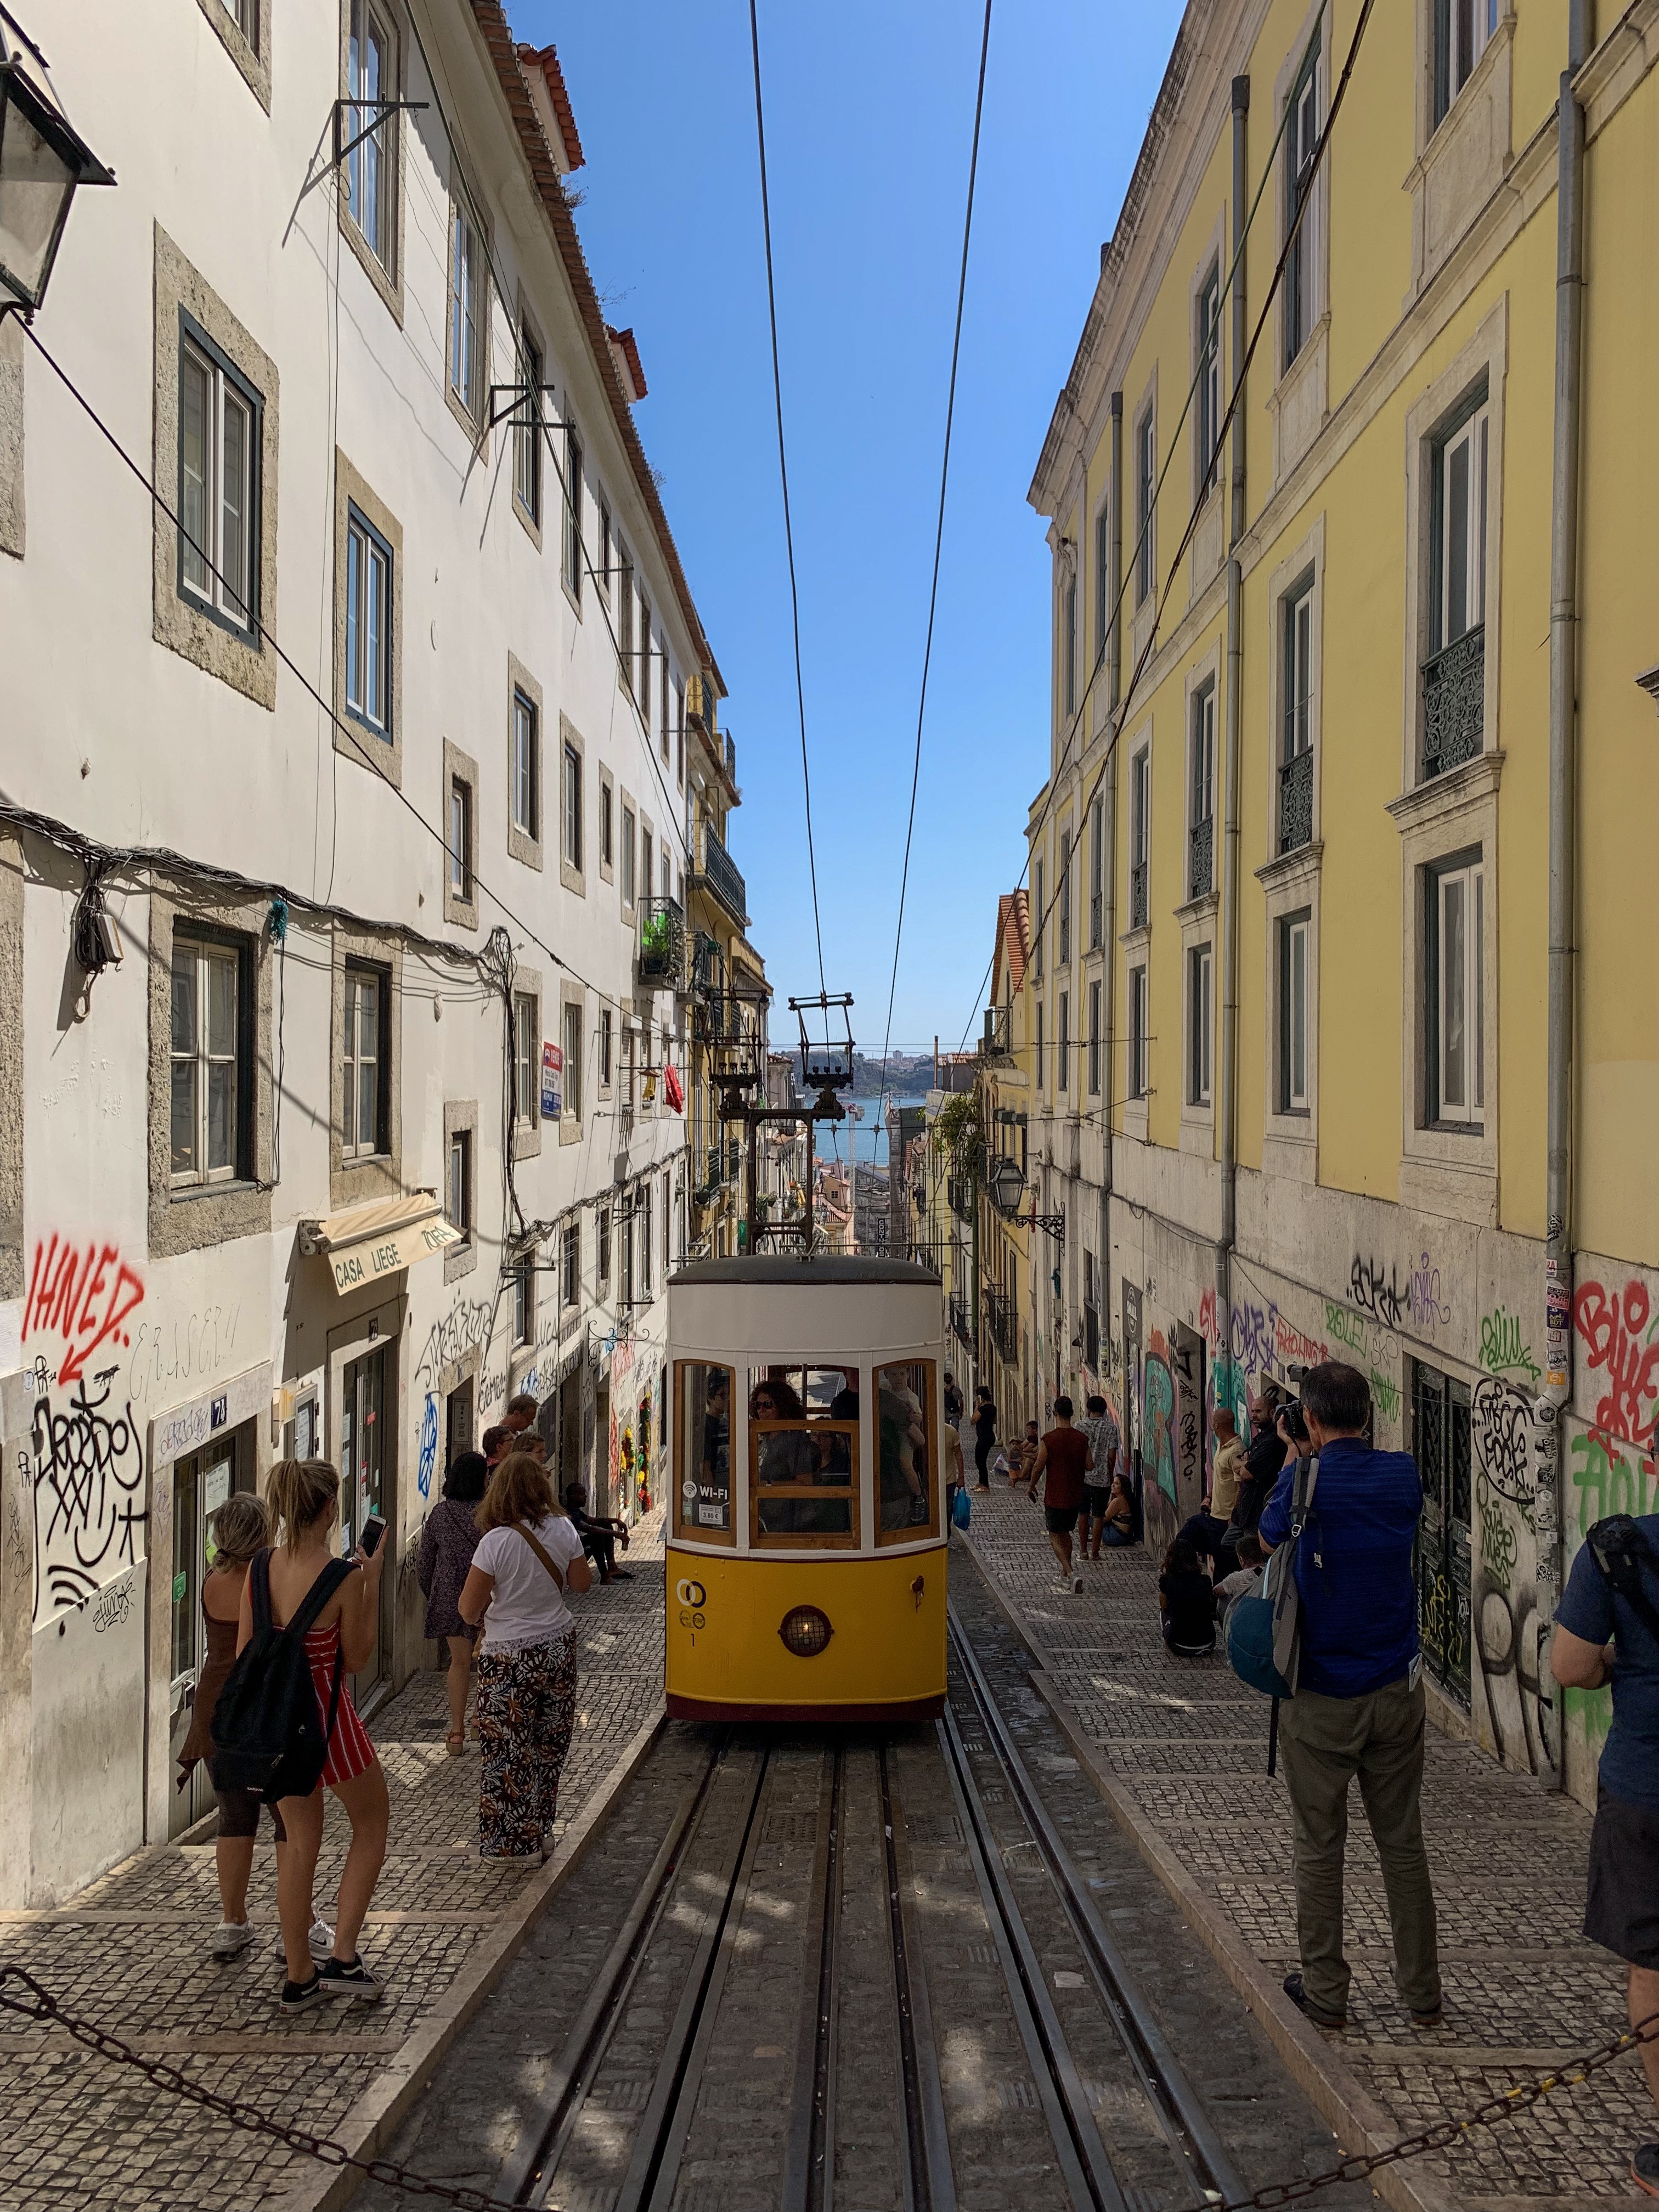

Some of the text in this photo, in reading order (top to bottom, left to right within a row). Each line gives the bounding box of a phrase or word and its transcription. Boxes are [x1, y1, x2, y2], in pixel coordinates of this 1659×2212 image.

[335, 1257, 366, 1288] CASA
[371, 1243, 402, 1273] LIEGE
[215, 1398, 225, 1426] 74
[699, 1485, 727, 1500] WI-FI
